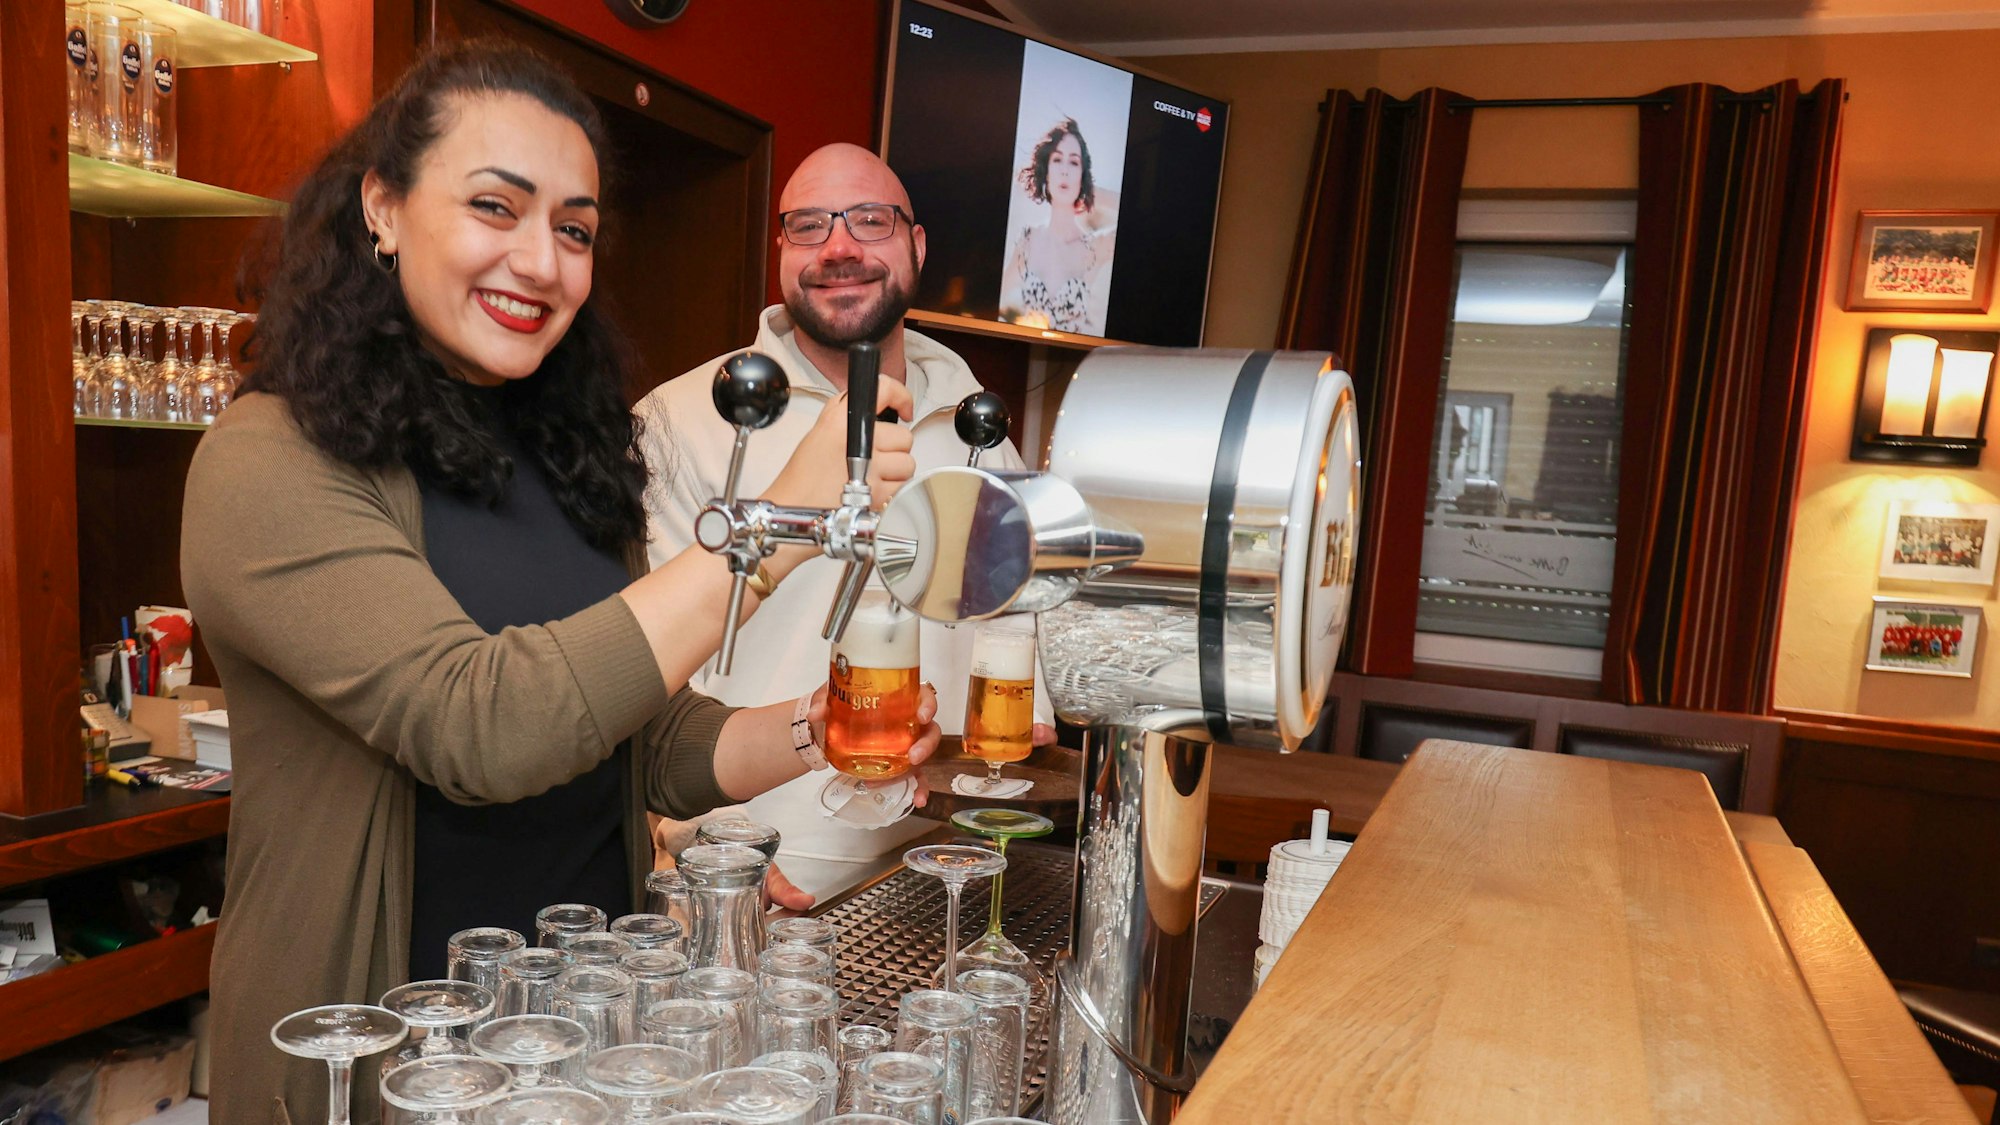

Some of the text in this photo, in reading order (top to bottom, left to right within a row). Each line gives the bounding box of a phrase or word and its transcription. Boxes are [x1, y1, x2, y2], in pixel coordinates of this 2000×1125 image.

[1153, 100, 1181, 117] COFFEE
[1180, 108, 1187, 119] &
[1186, 110, 1197, 121] TV
